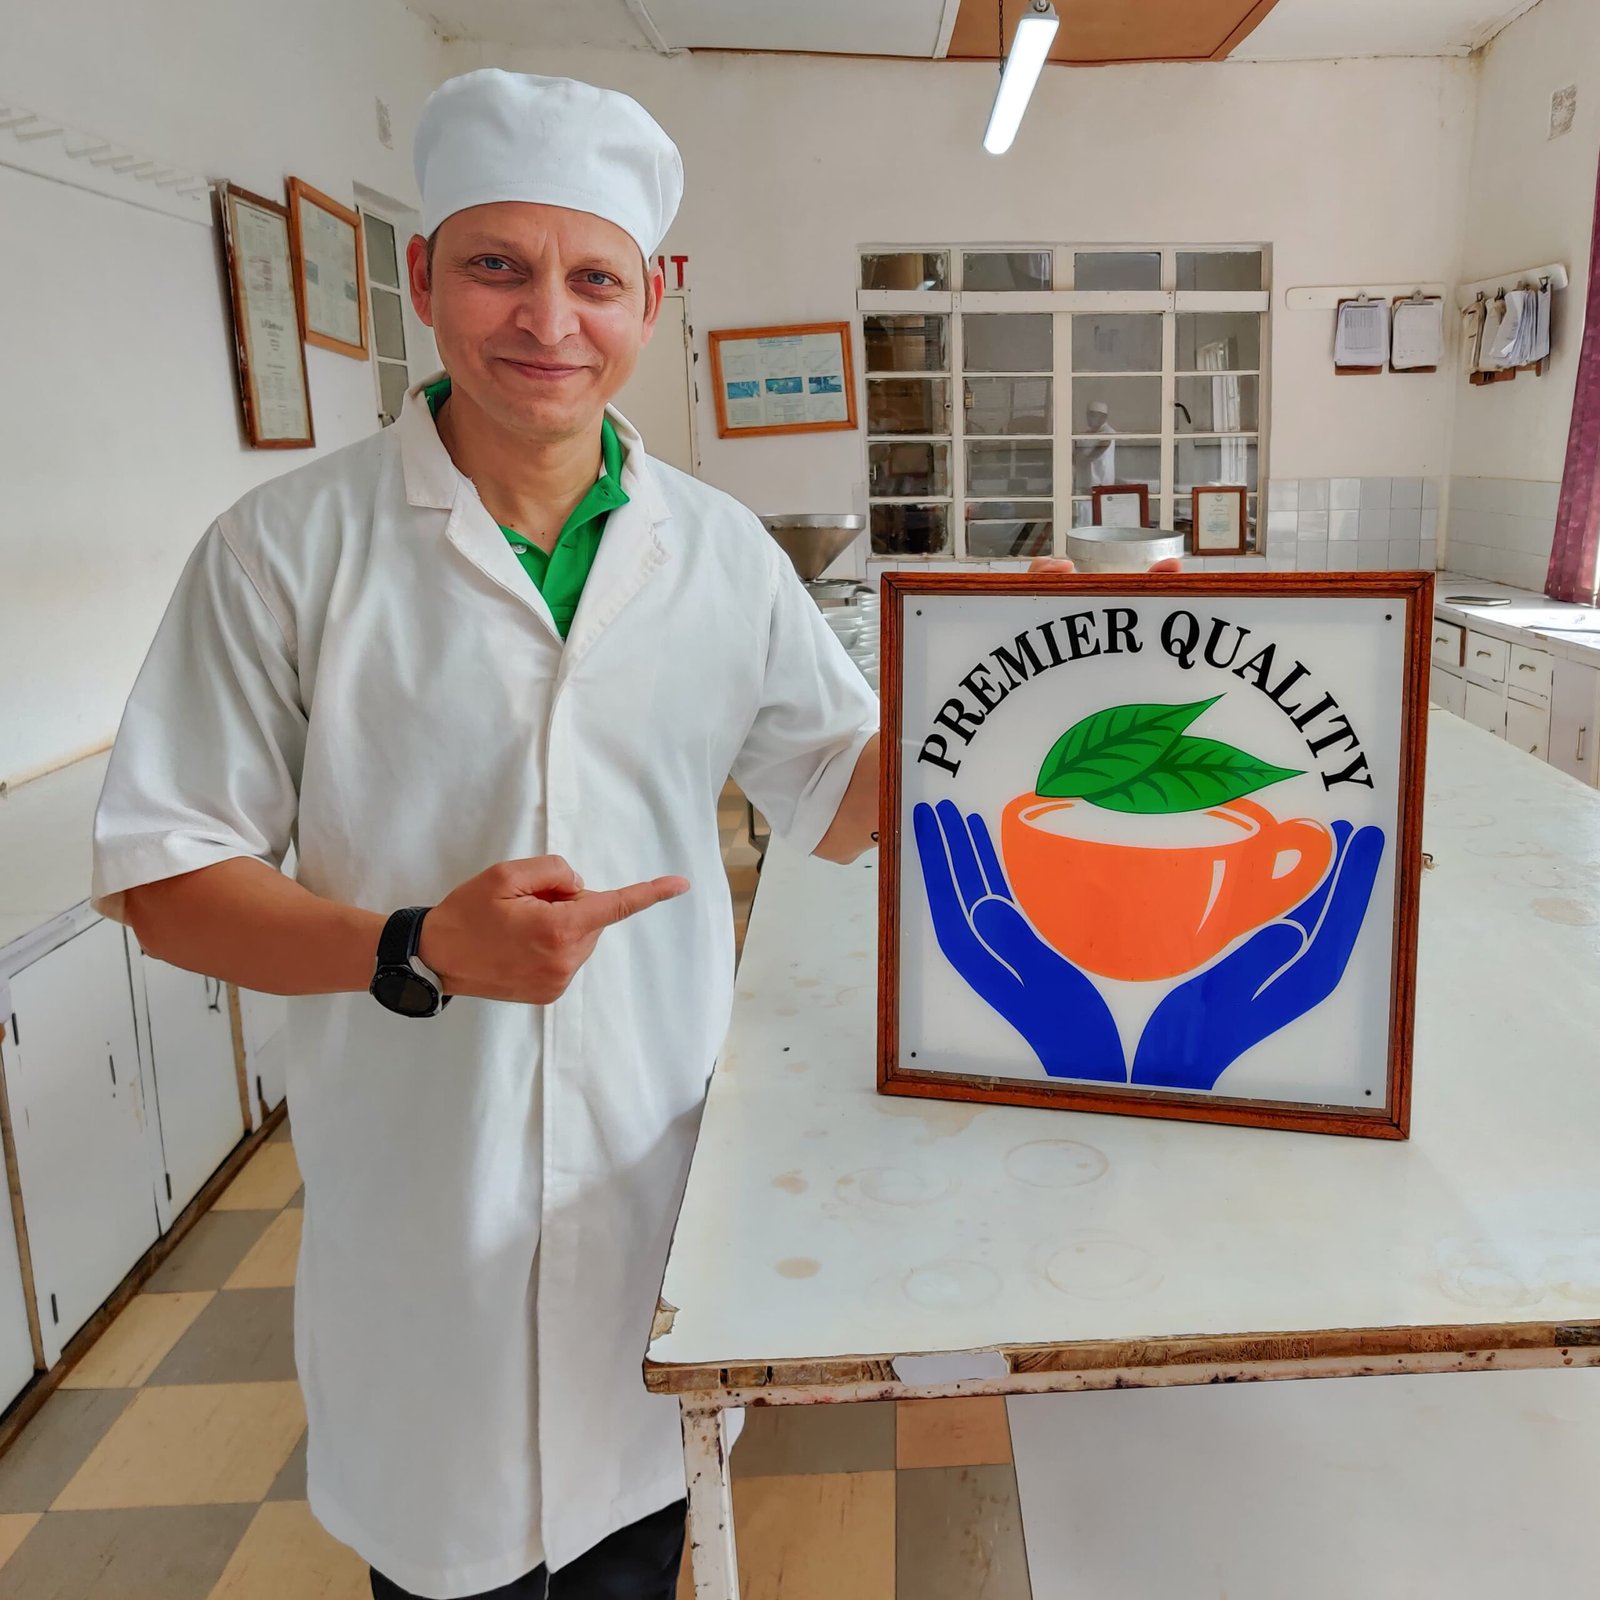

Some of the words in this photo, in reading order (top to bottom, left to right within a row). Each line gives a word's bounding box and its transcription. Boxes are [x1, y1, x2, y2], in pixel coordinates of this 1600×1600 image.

[657, 255, 689, 289] IT
[917, 607, 1144, 779] PREMIER
[1160, 610, 1375, 792] QUALITY
